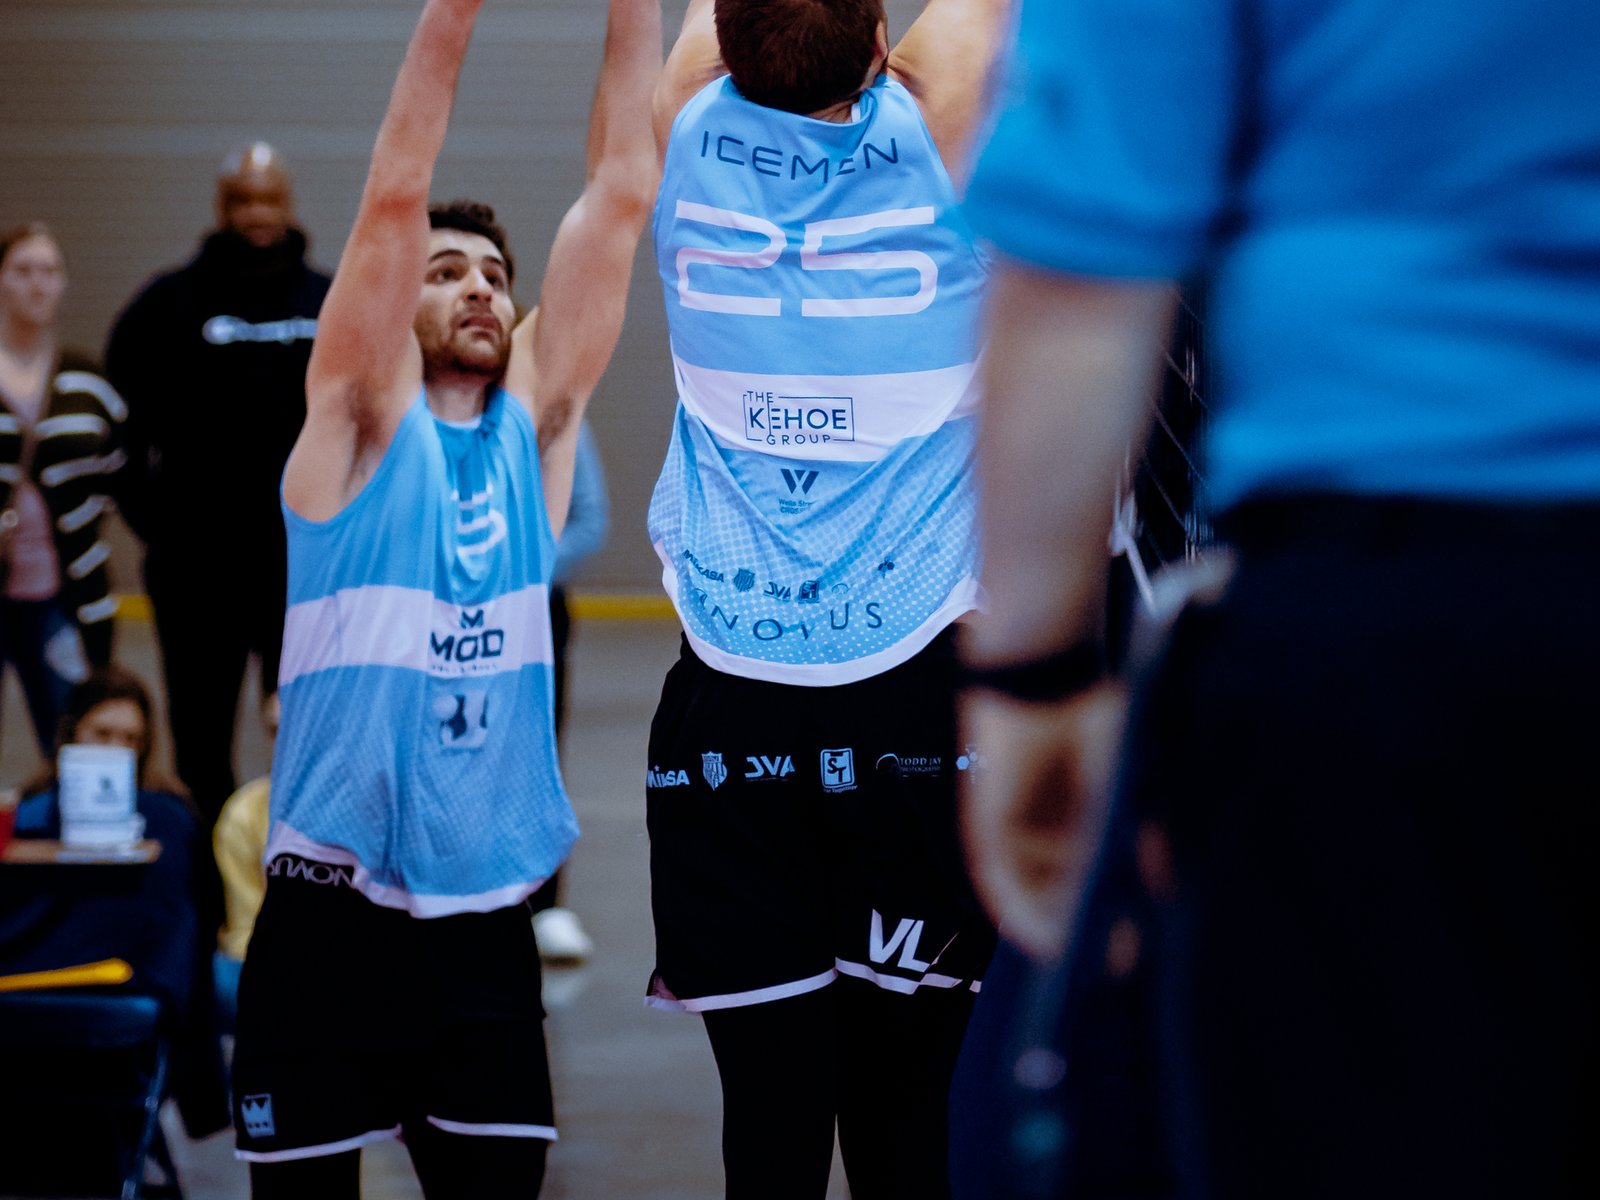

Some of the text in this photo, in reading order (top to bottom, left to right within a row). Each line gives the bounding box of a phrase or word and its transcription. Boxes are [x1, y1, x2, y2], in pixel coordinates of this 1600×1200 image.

[674, 199, 939, 317] 25
[746, 390, 774, 403] THE
[749, 407, 847, 430] KEHOE
[766, 434, 831, 445] GROUP
[431, 629, 503, 662] MOD
[744, 755, 795, 779] JVA
